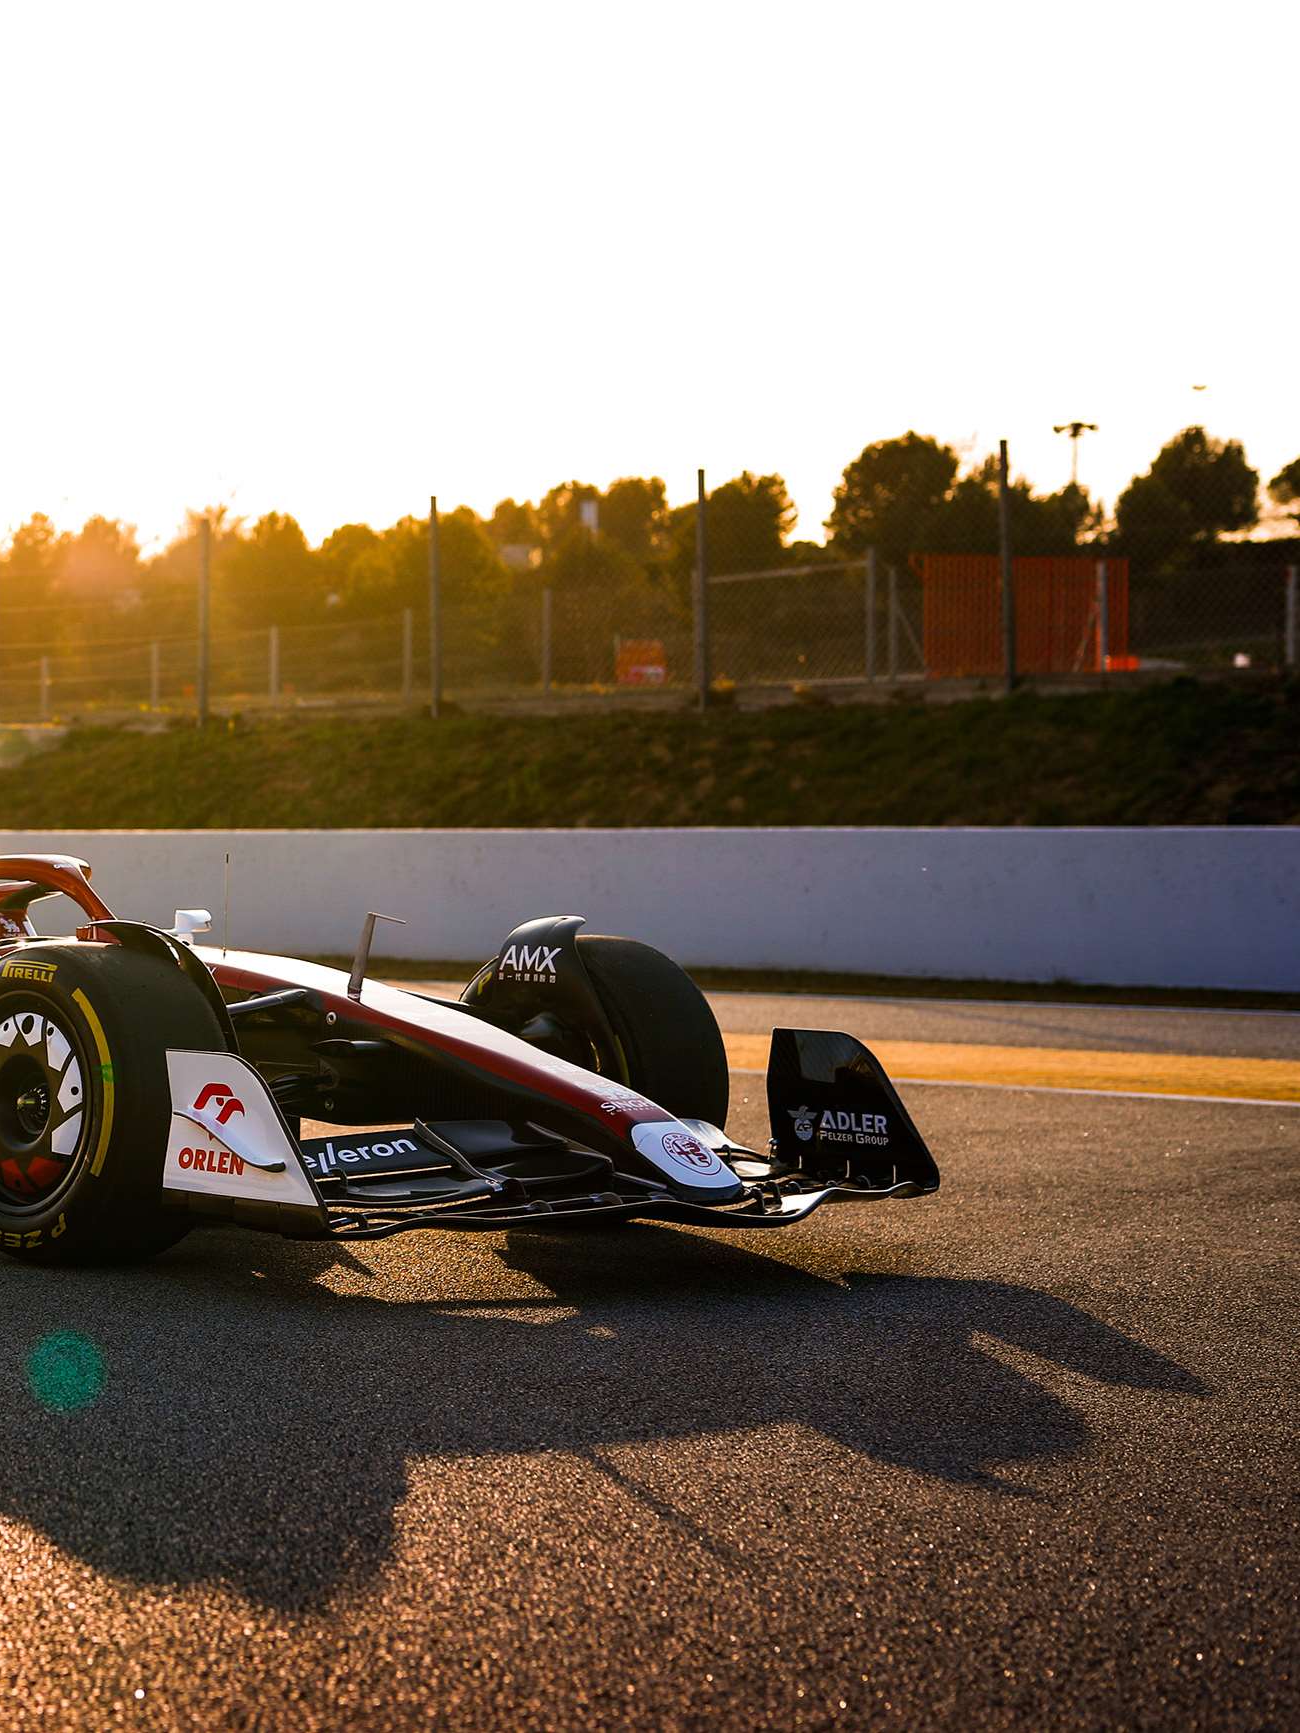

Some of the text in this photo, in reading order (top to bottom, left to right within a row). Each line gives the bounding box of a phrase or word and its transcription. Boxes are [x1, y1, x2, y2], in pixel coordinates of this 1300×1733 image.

[1, 959, 58, 983] PIRELLI
[499, 944, 563, 974] AMX
[820, 1109, 888, 1135] ADLER
[178, 1147, 245, 1176] ORLEN
